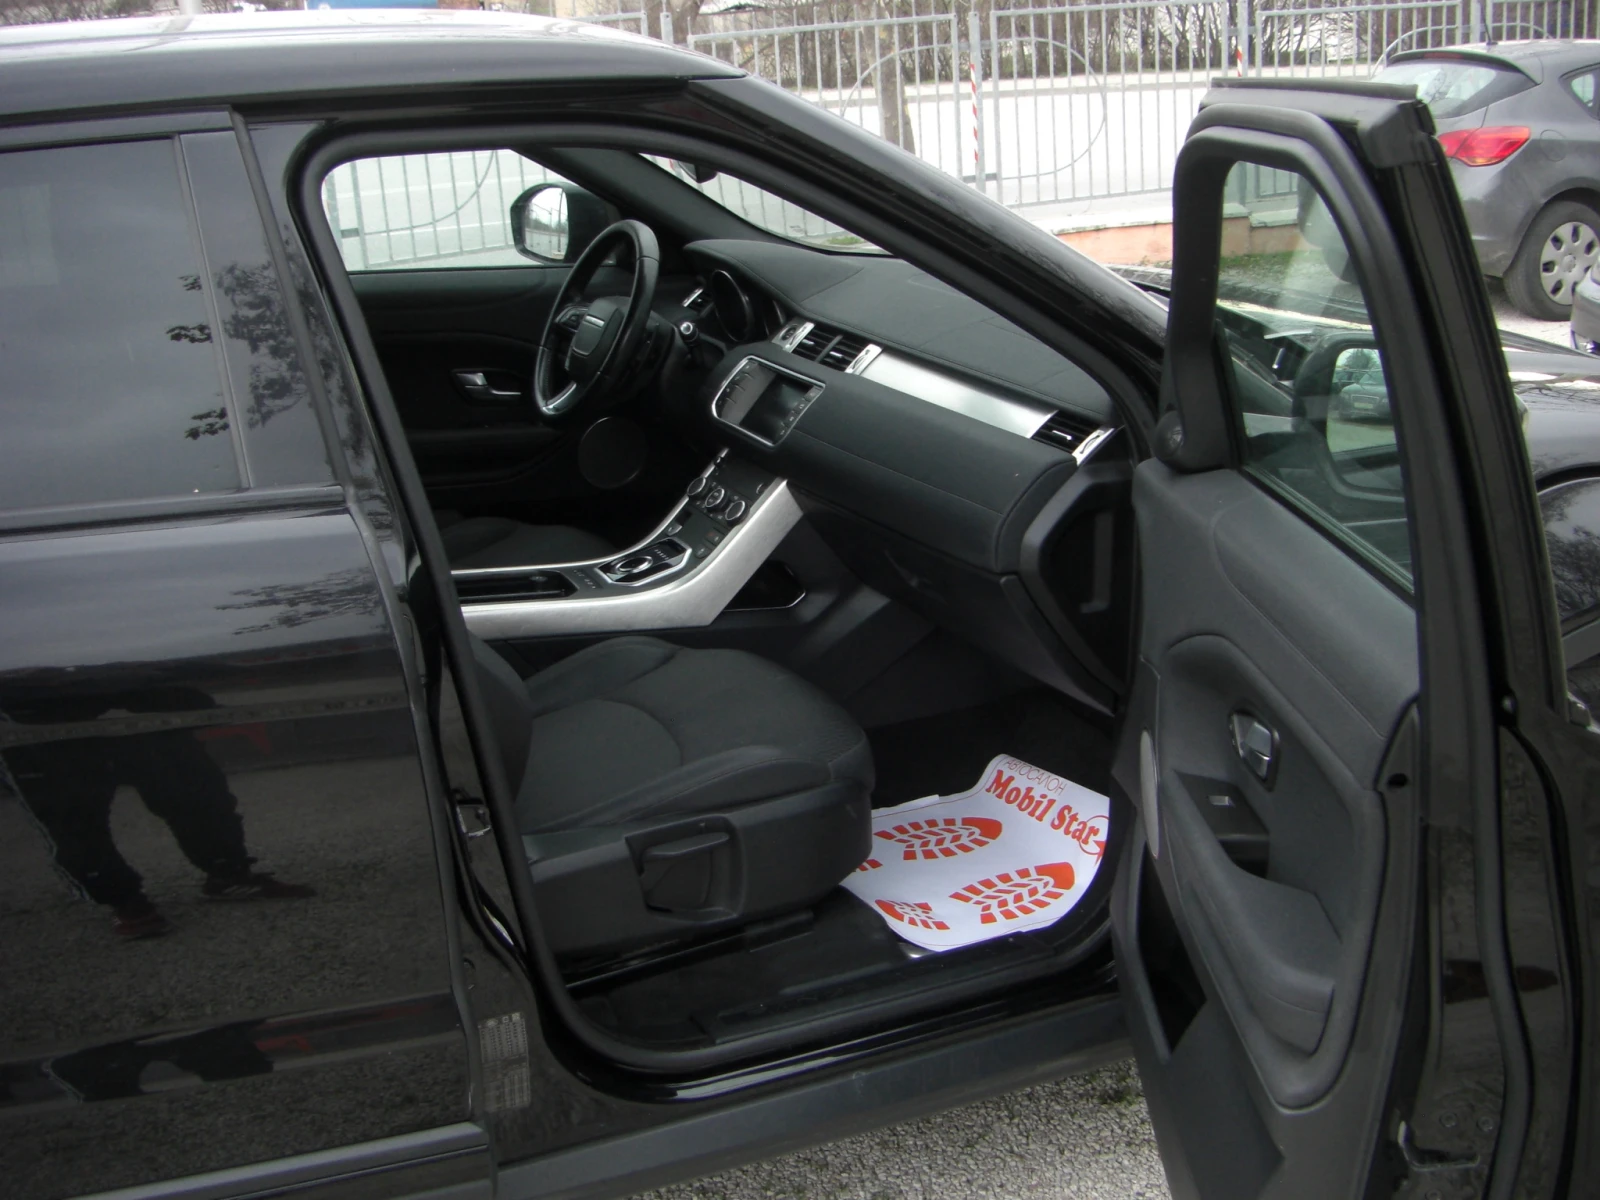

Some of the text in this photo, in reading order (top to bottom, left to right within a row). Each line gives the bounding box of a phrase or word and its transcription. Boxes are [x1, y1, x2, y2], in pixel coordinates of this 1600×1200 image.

[1004, 759, 1067, 795] АВТОСАЛОН
[985, 769, 1100, 845] Mobil Star
